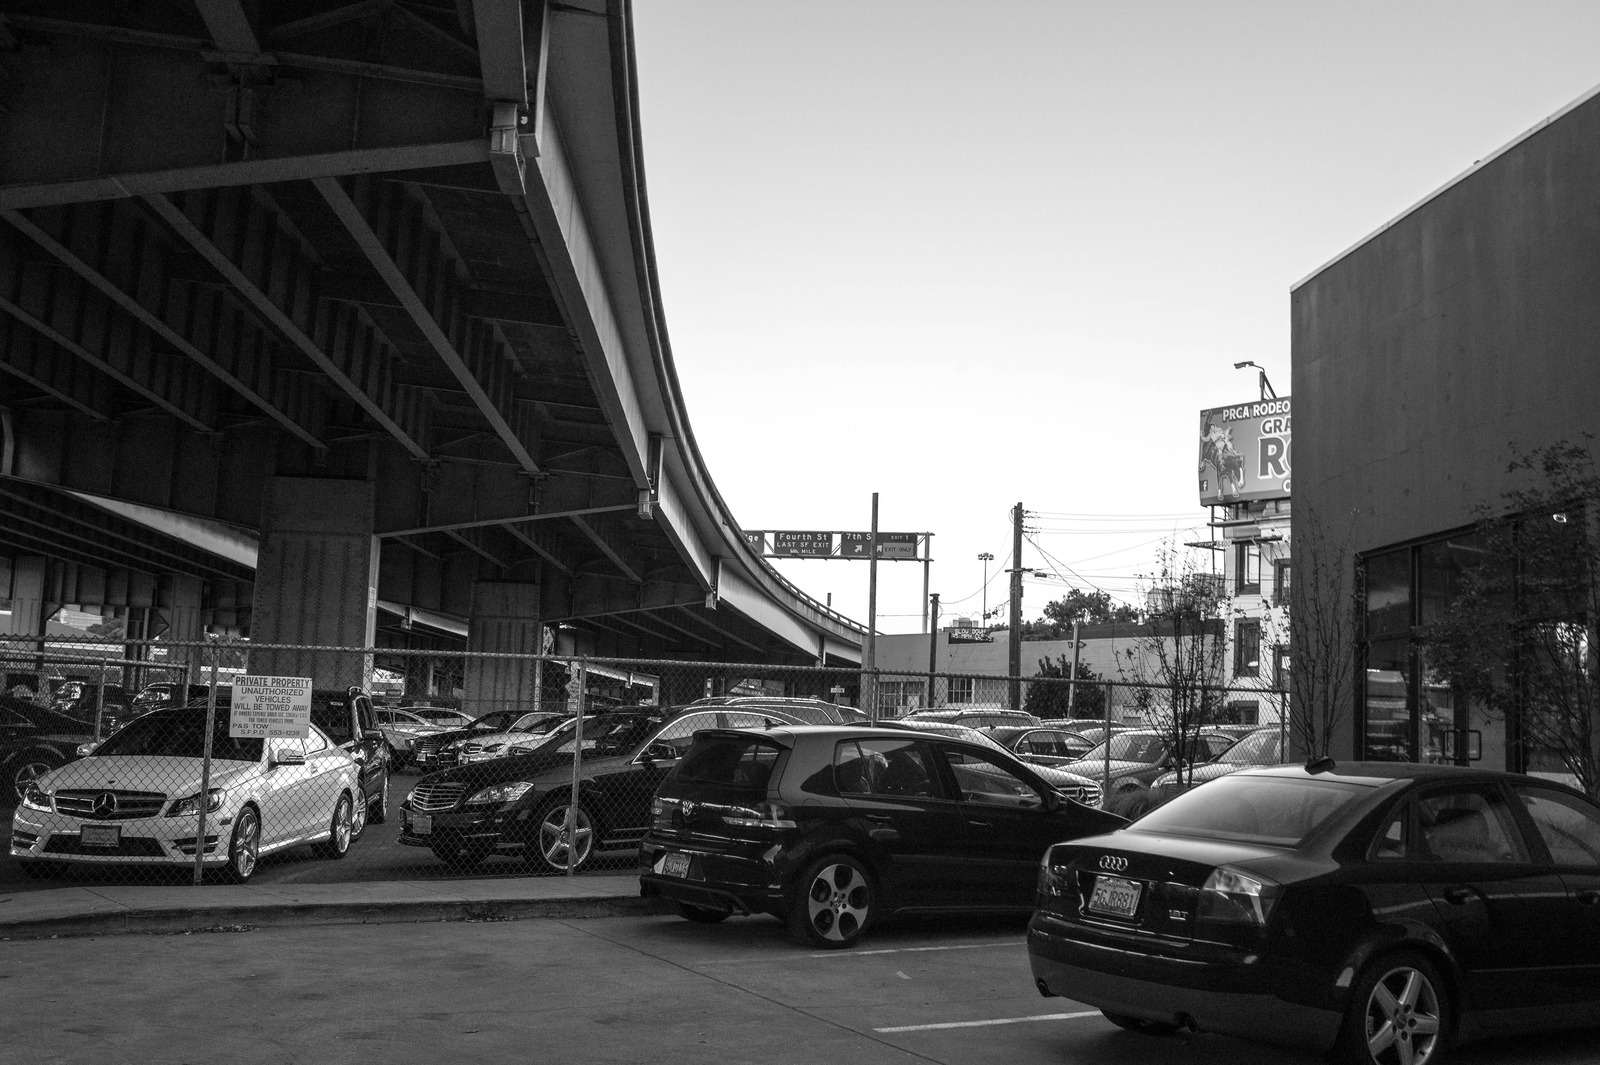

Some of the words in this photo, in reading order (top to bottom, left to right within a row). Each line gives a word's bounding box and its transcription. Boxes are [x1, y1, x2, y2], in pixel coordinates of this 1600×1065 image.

[1223, 406, 1249, 420] PRCA
[1253, 400, 1290, 416] RODEO
[1258, 436, 1291, 478] R
[236, 676, 268, 686] PRIVATE
[272, 678, 309, 688] PROPERTY
[242, 687, 304, 696] UNAUTHORIZED
[1094, 888, 1134, 910] 5GJR881
